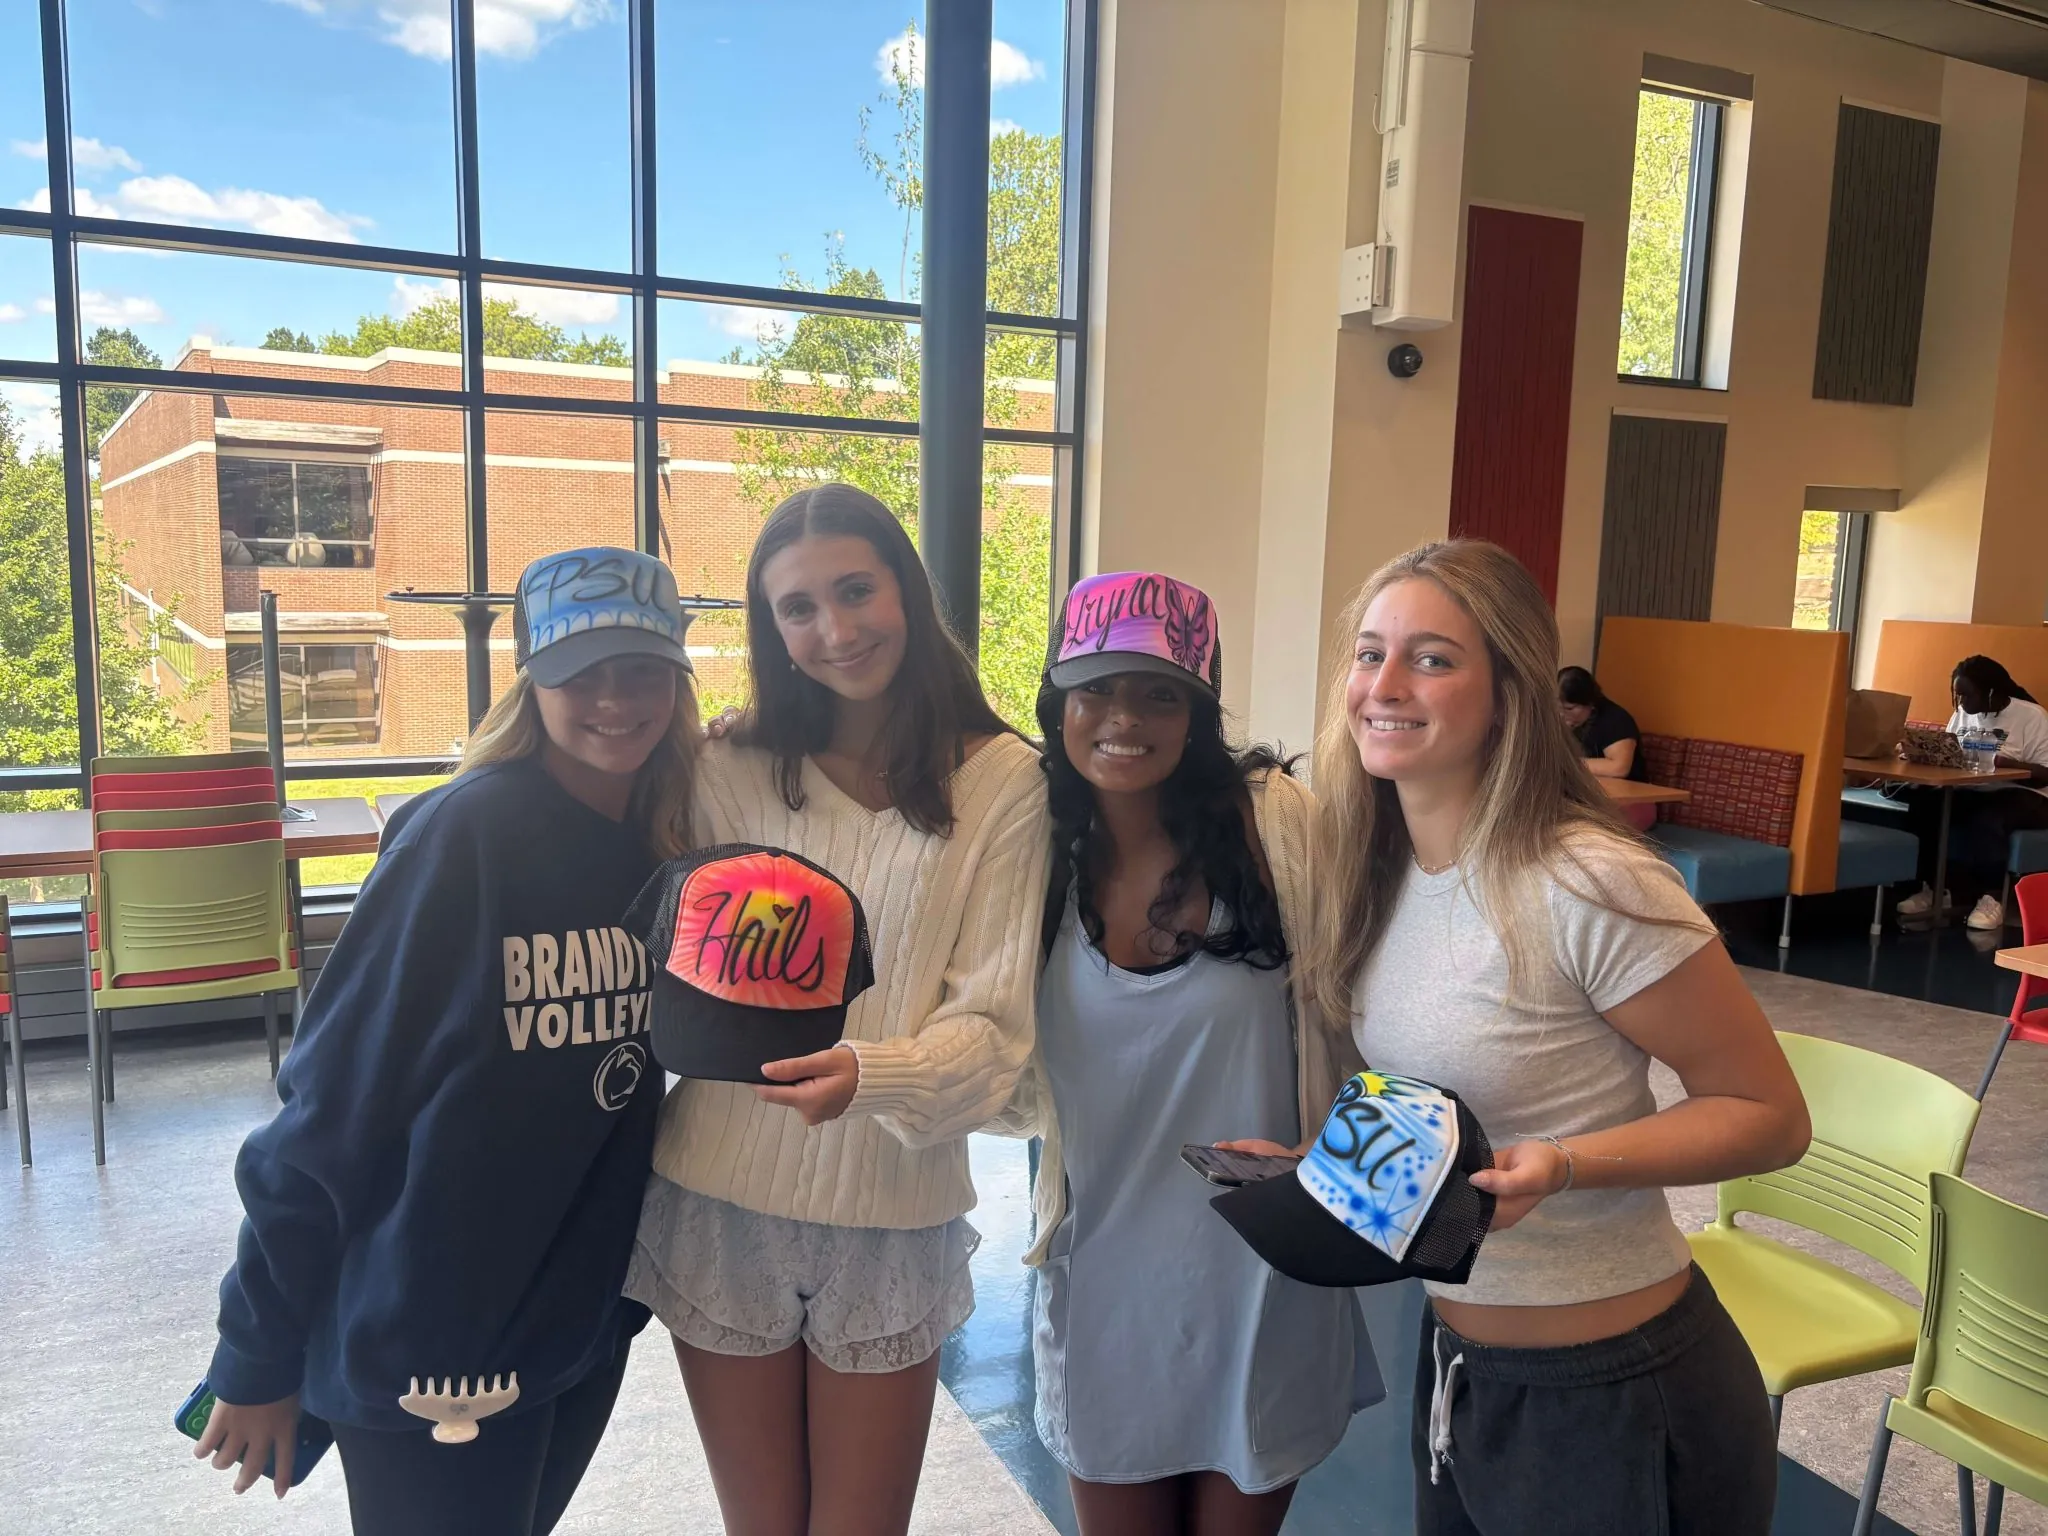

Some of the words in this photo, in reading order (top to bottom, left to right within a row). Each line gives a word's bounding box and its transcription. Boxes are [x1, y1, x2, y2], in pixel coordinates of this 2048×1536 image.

[524, 556, 669, 612] PSU
[503, 926, 655, 1002] BRANDY
[693, 890, 825, 992] Hails
